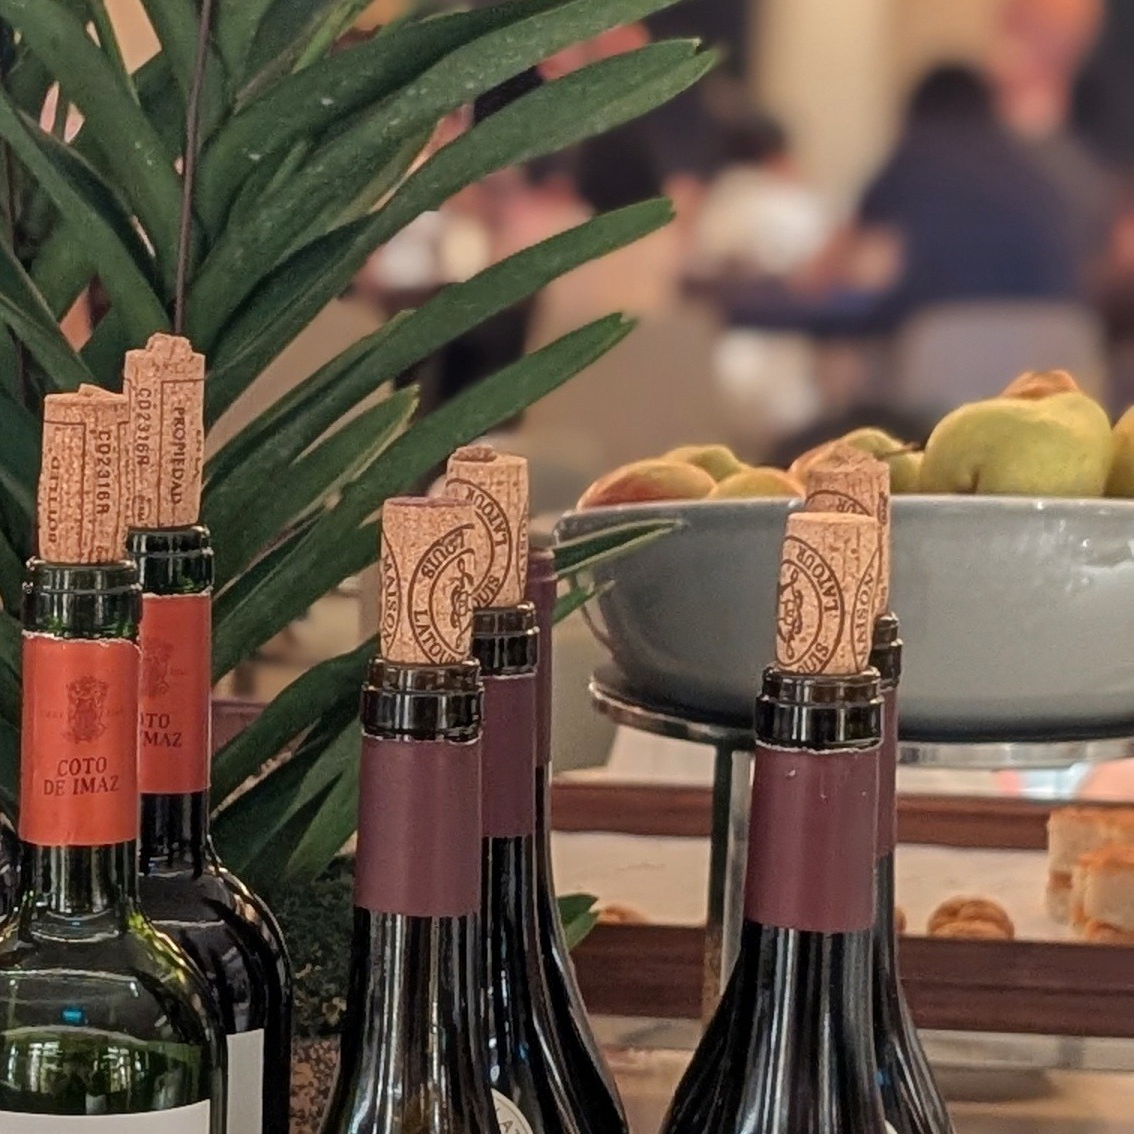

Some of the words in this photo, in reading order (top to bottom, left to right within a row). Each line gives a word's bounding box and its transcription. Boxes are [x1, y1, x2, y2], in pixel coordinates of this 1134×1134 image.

[170, 407, 185, 505] PROPIEDAD
[47, 457, 60, 544] BOTTLED
[796, 545, 839, 613] LATOUR
[142, 731, 181, 747] MAZ
[44, 779, 65, 795] DE
[73, 776, 119, 795] IMAZ
[57, 757, 107, 777] COTO
